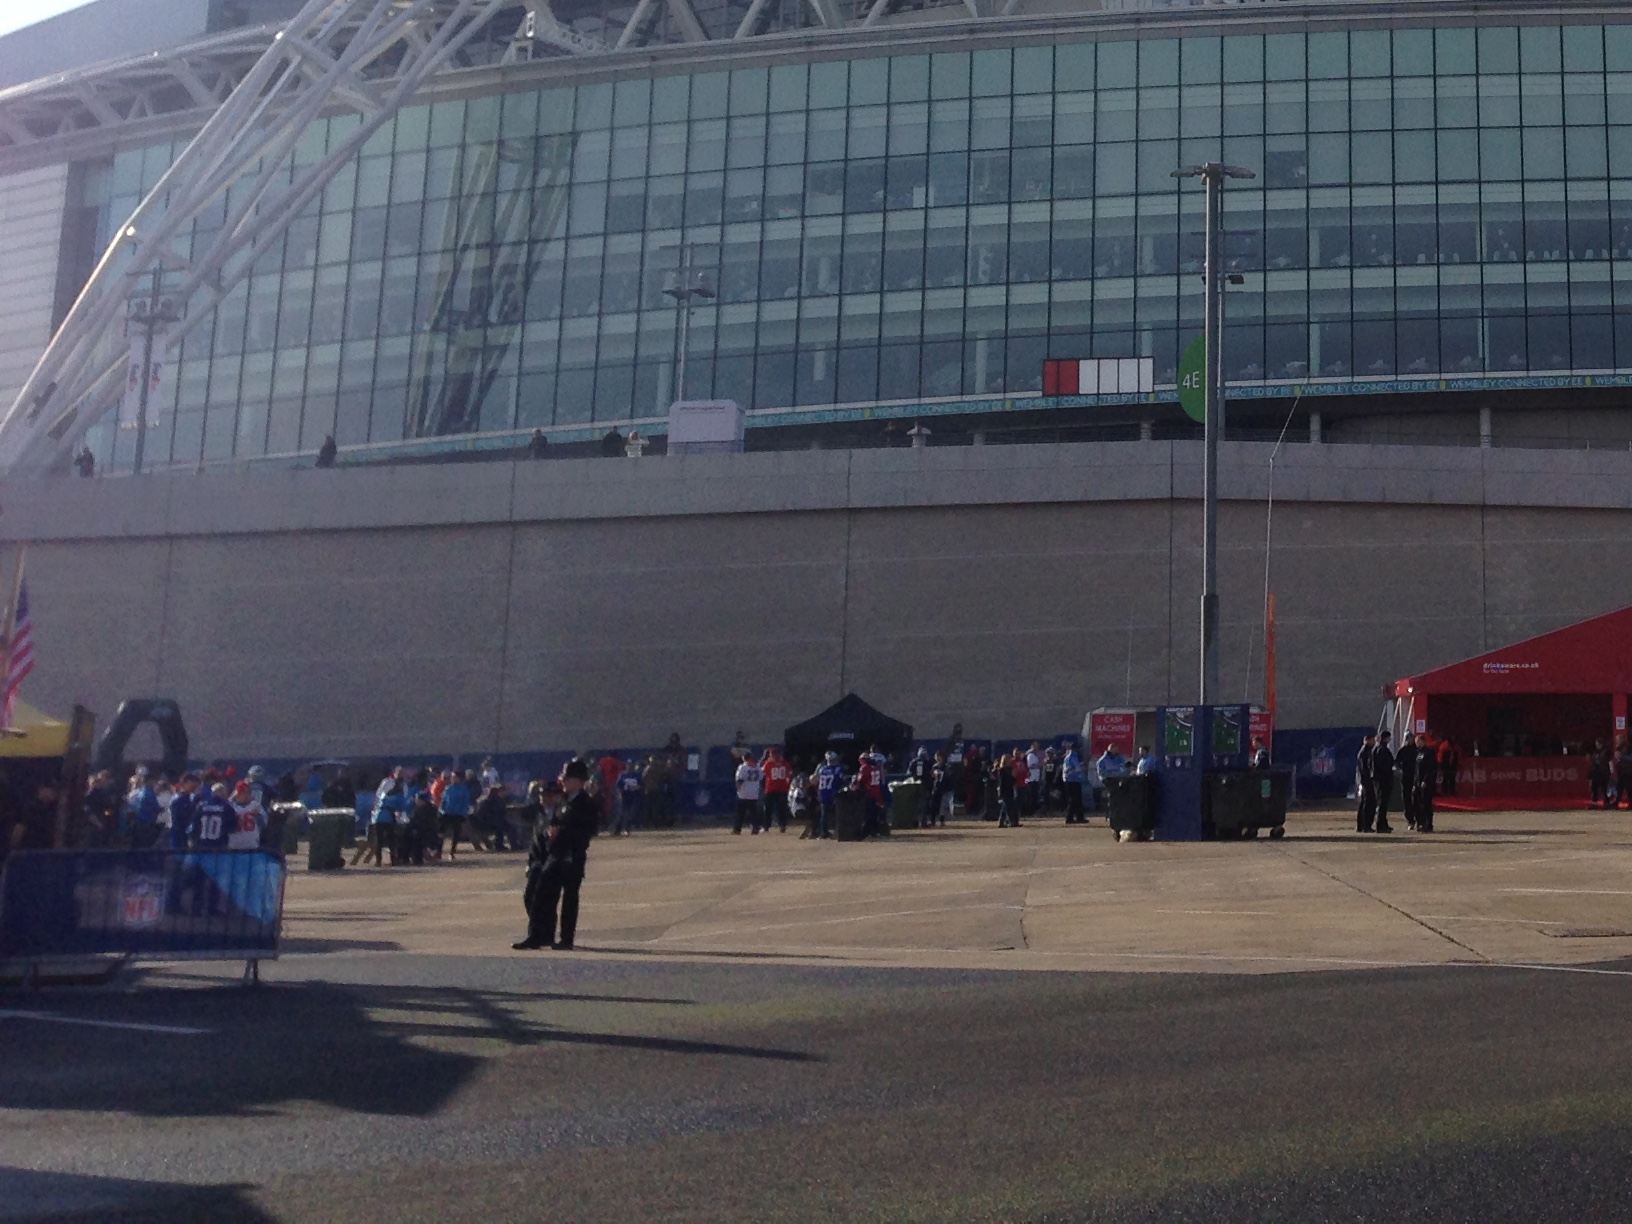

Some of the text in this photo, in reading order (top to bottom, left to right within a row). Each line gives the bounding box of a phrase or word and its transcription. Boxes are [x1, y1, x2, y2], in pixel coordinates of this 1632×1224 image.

[1182, 371, 1199, 389] 4E
[1304, 384, 1350, 394] WEMBLEY
[1352, 381, 1410, 392] CONNECTED
[1412, 381, 1424, 390] BY
[1450, 378, 1496, 389] WEMBLEY
[1498, 376, 1556, 387] CONNECTED
[1558, 376, 1571, 386] BY
[1103, 715, 1123, 724] CASH
[818, 774, 835, 790] 87
[1525, 767, 1579, 782] BUDS
[199, 815, 223, 840] 10
[123, 896, 159, 922] NFL
